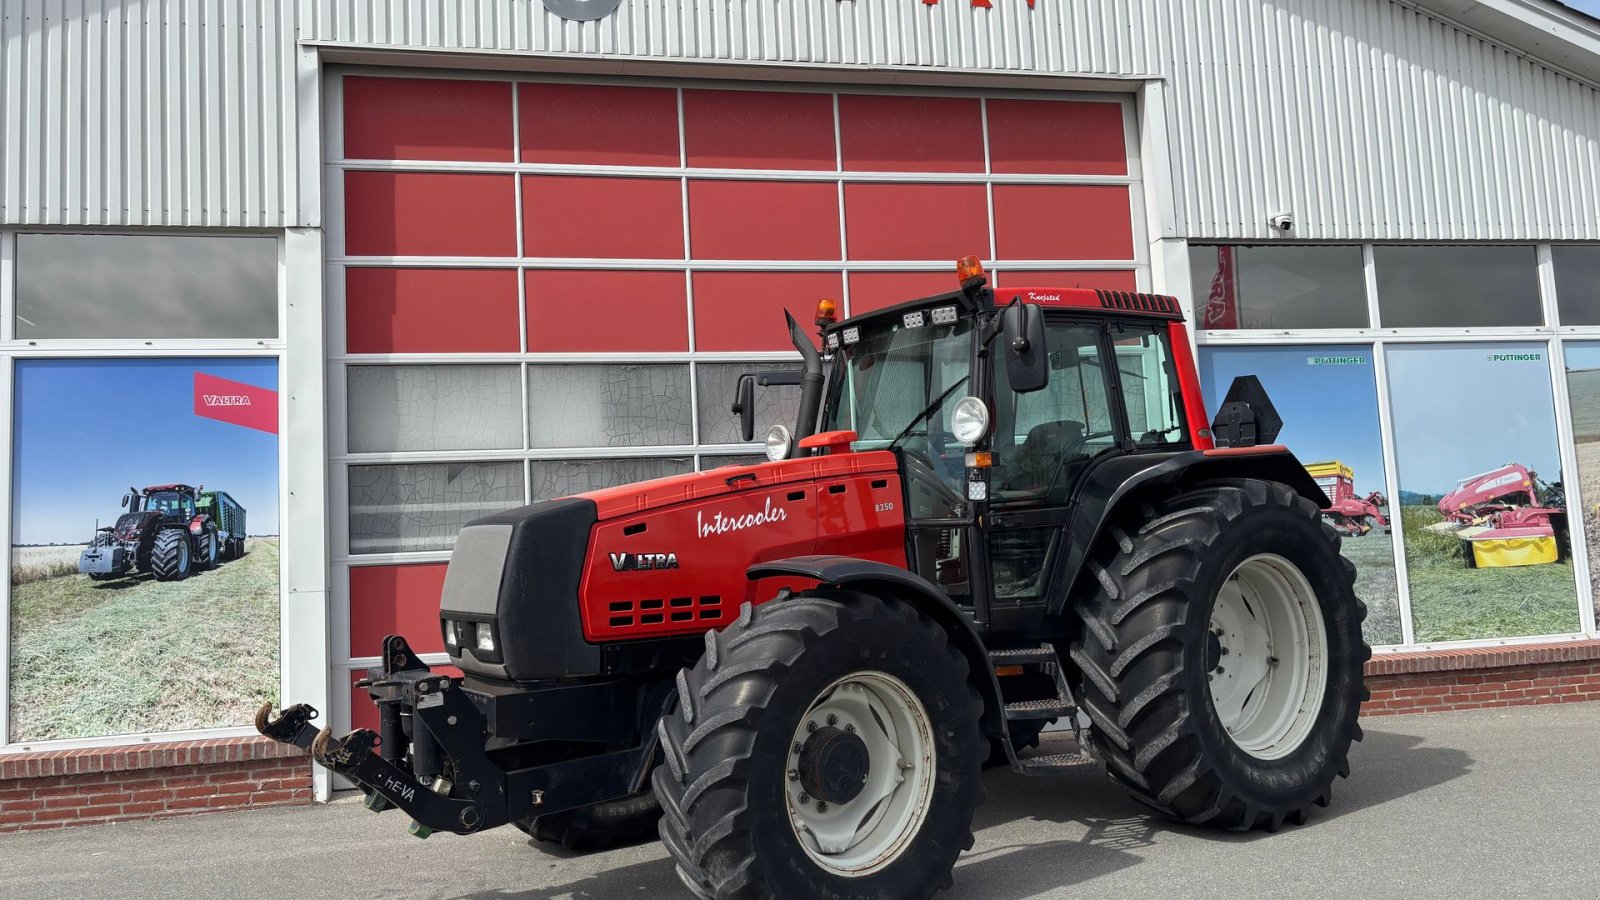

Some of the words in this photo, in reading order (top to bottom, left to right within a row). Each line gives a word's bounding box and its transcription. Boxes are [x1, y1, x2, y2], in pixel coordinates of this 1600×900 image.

[203, 394, 251, 406] VALTRA
[875, 502, 894, 512] 8350
[697, 496, 787, 538] Intercooler
